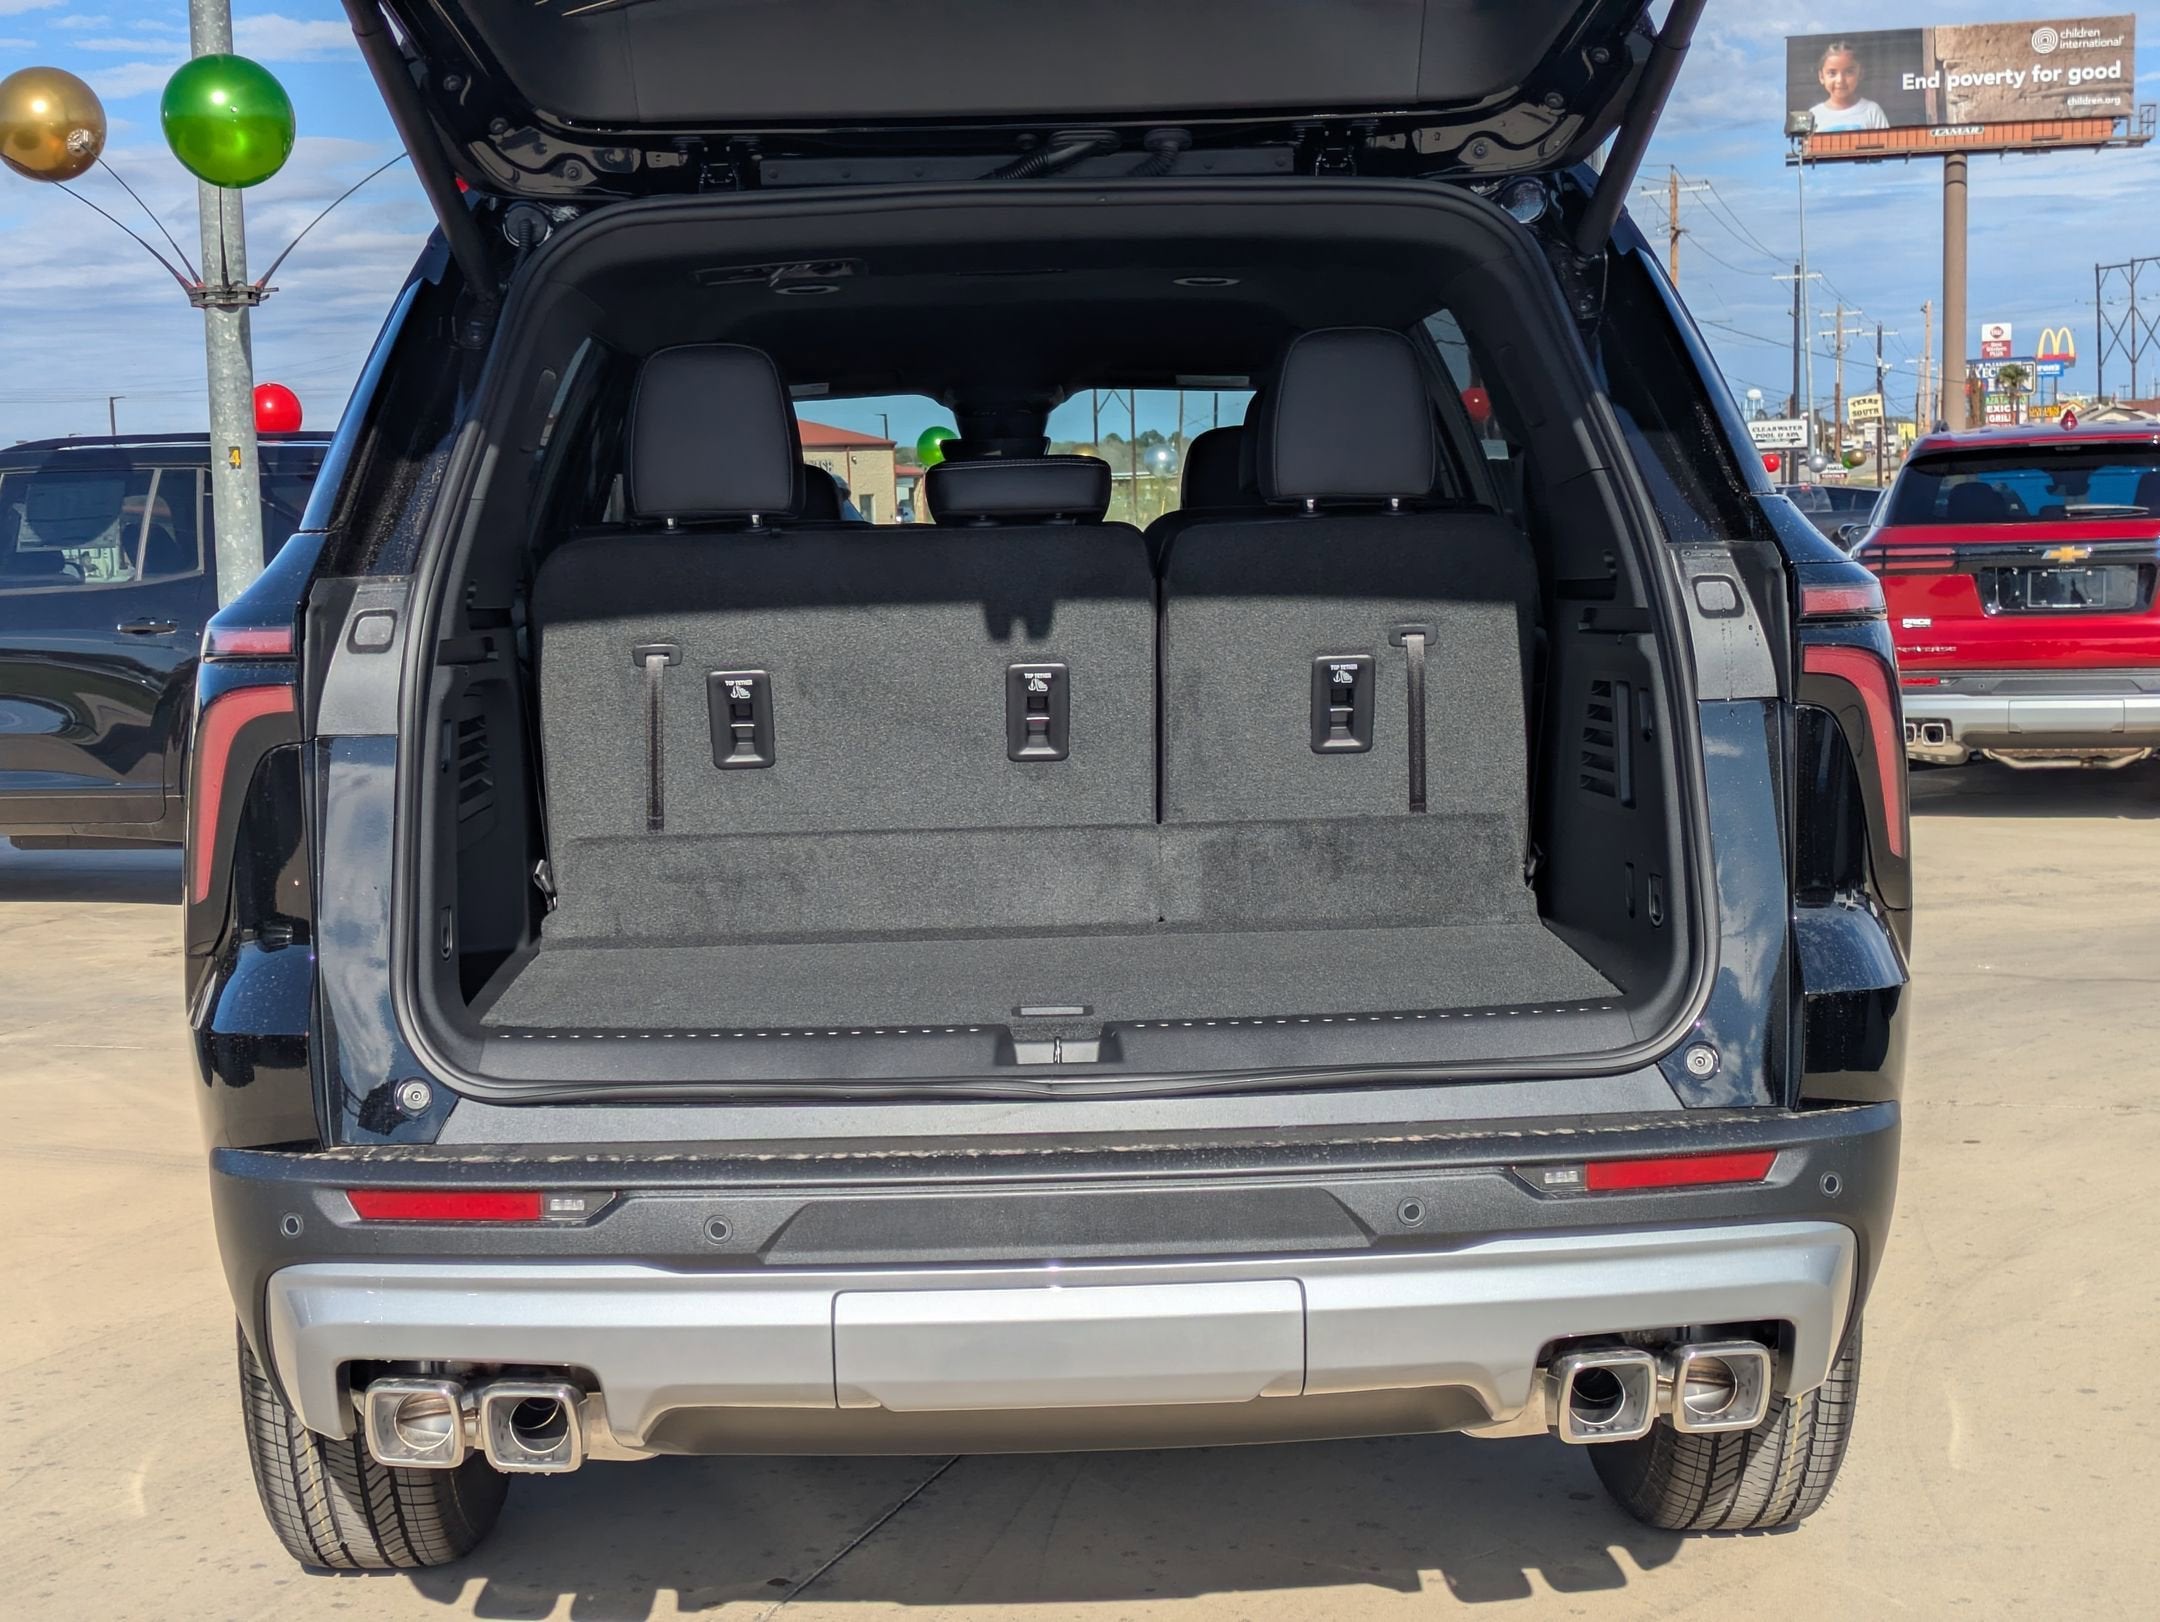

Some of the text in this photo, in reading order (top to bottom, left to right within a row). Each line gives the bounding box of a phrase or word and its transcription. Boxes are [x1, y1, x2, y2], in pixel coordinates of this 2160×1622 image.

[2060, 27, 2100, 39] children
[2060, 36, 2122, 49] international
[1902, 59, 2121, 92] End poverty for good
[2067, 96, 2121, 106] children.org
[1852, 408, 1880, 417] SOUTH
[1752, 424, 1803, 433] CLEARWATER
